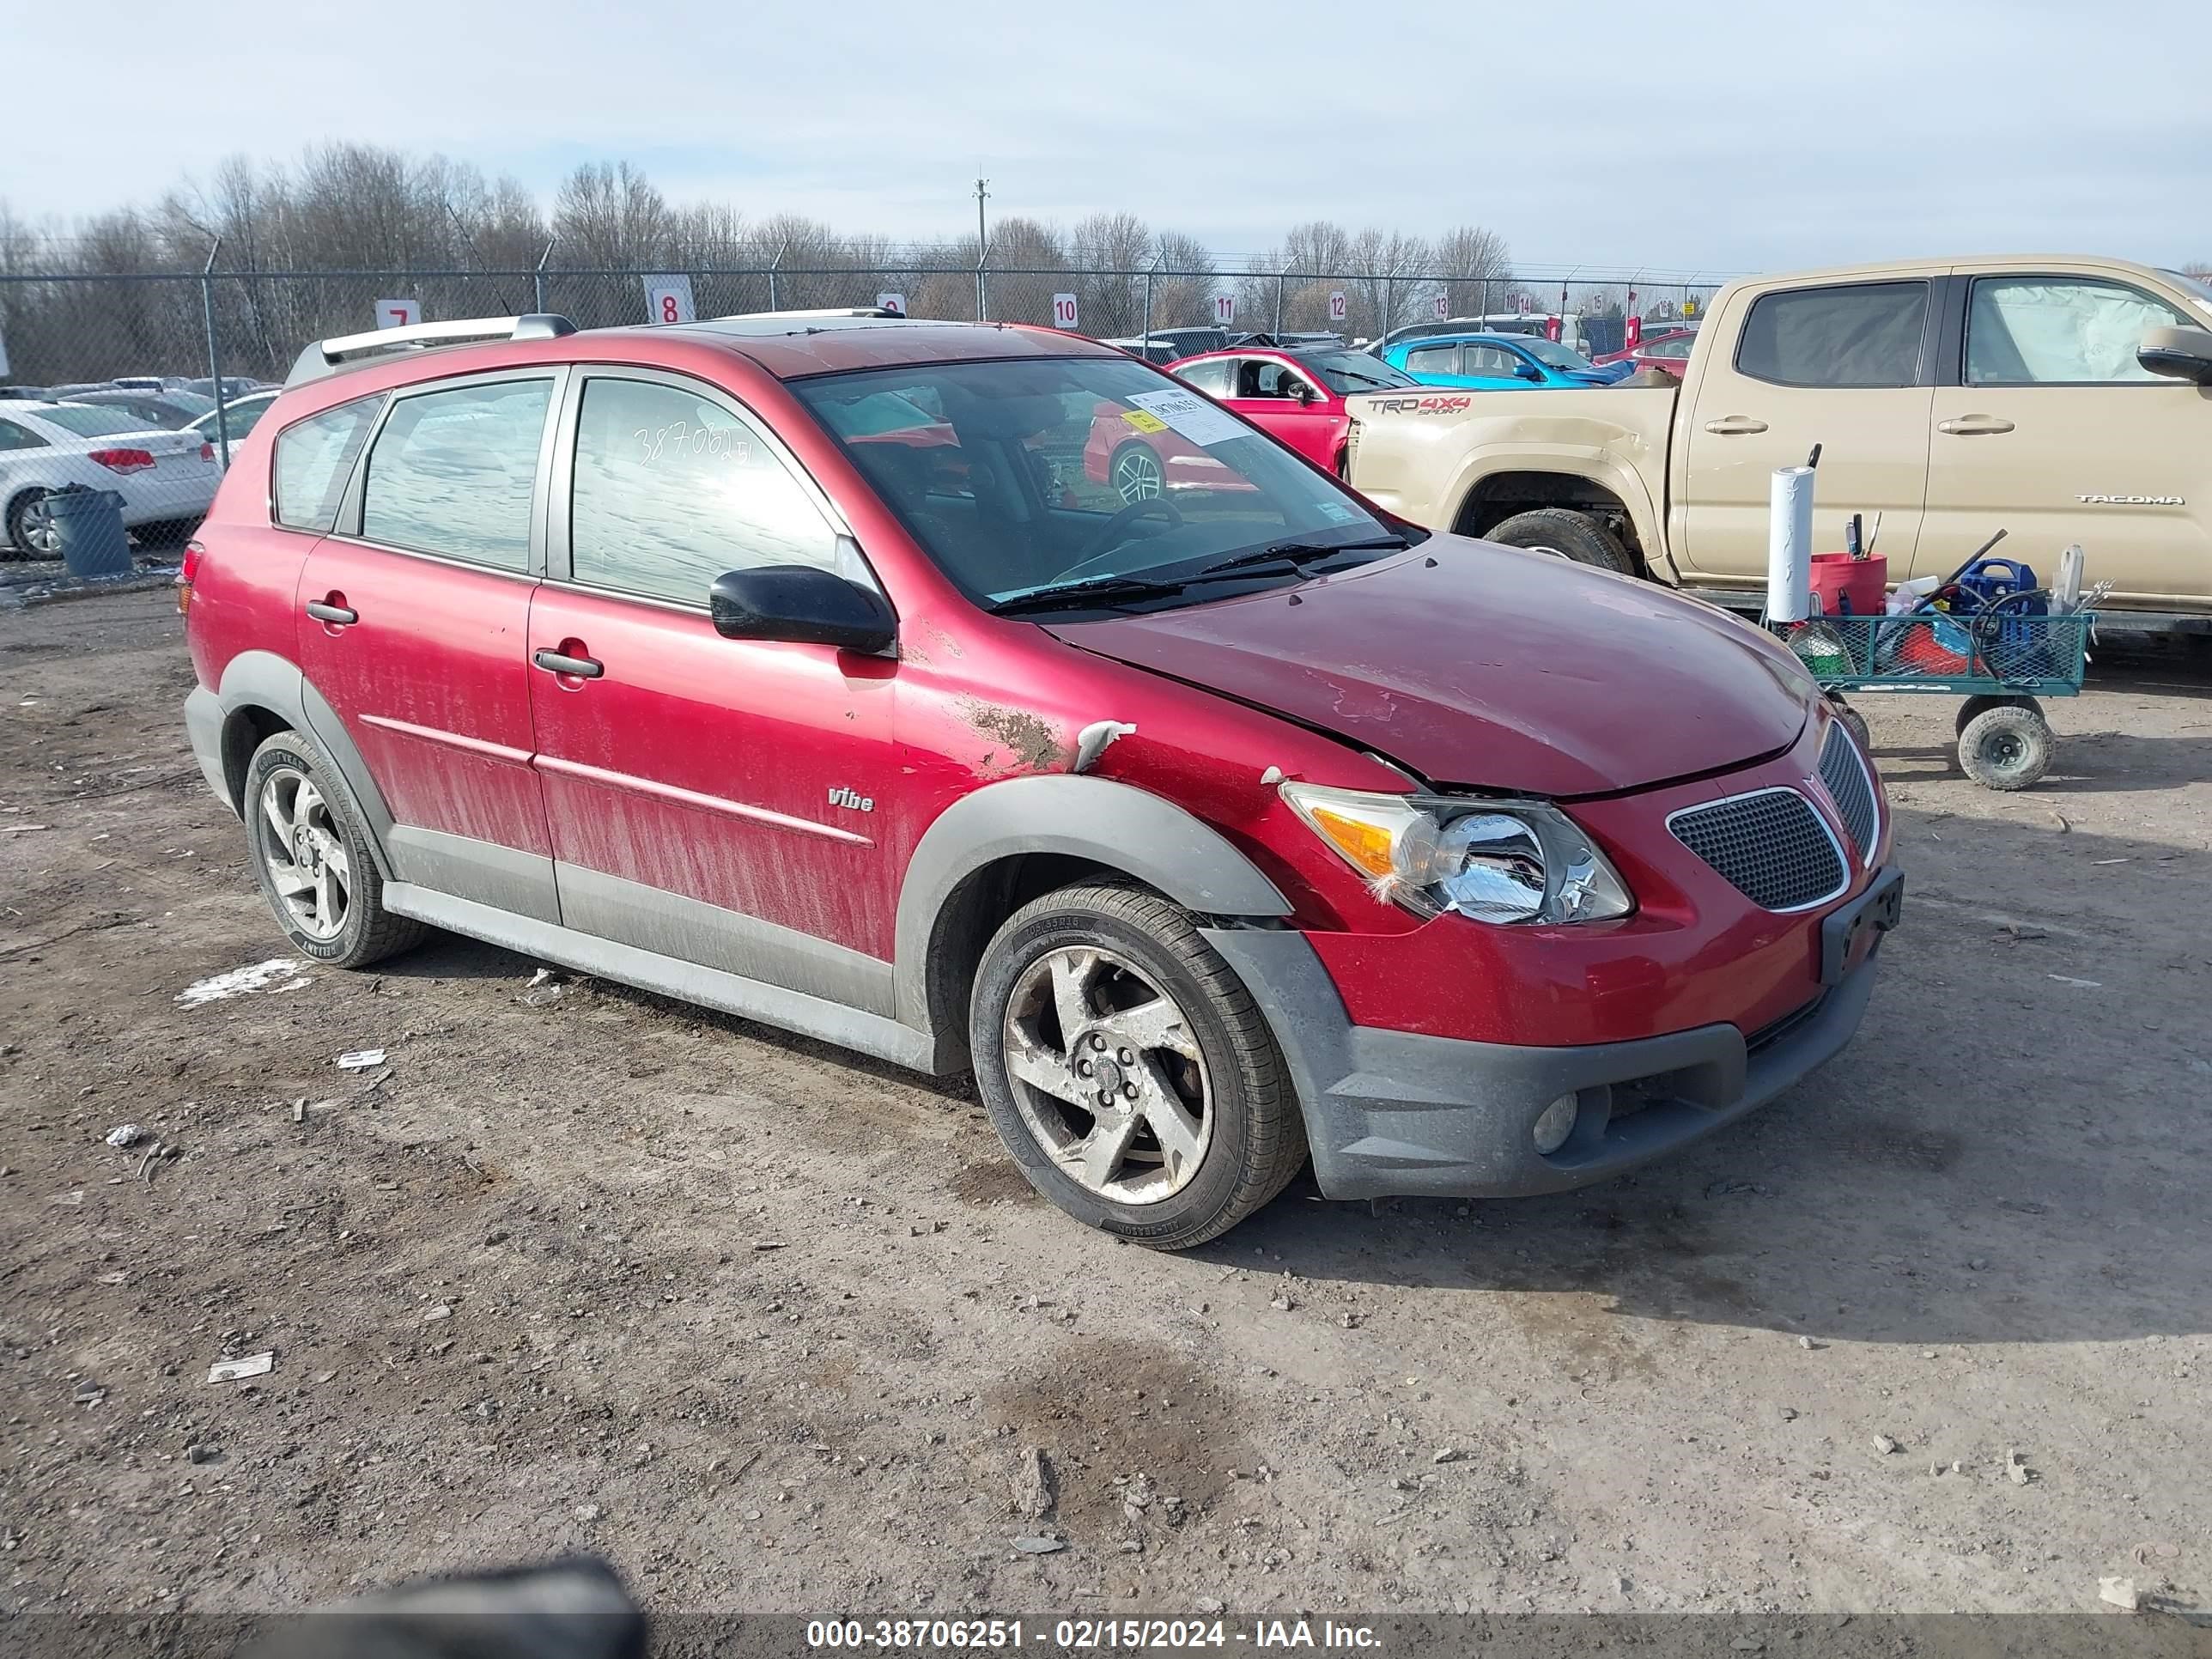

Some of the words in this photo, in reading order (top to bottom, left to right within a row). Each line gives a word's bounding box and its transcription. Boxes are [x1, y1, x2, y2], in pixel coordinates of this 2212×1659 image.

[662, 295, 678, 323] 8
[1217, 296, 1233, 319] 11
[1331, 296, 1345, 316] 12
[1435, 297, 1448, 315] 13
[1506, 294, 1516, 309] 10
[1520, 297, 1530, 313] 14
[1593, 295, 1601, 310] 15
[389, 309, 407, 326] 7
[1055, 300, 1075, 321] 10
[1150, 399, 1203, 416] 38706251
[1367, 398, 1420, 415] TRD
[1416, 407, 1466, 416] SPORT
[2075, 495, 2186, 505] TACOMA
[828, 787, 874, 812] Vibe
